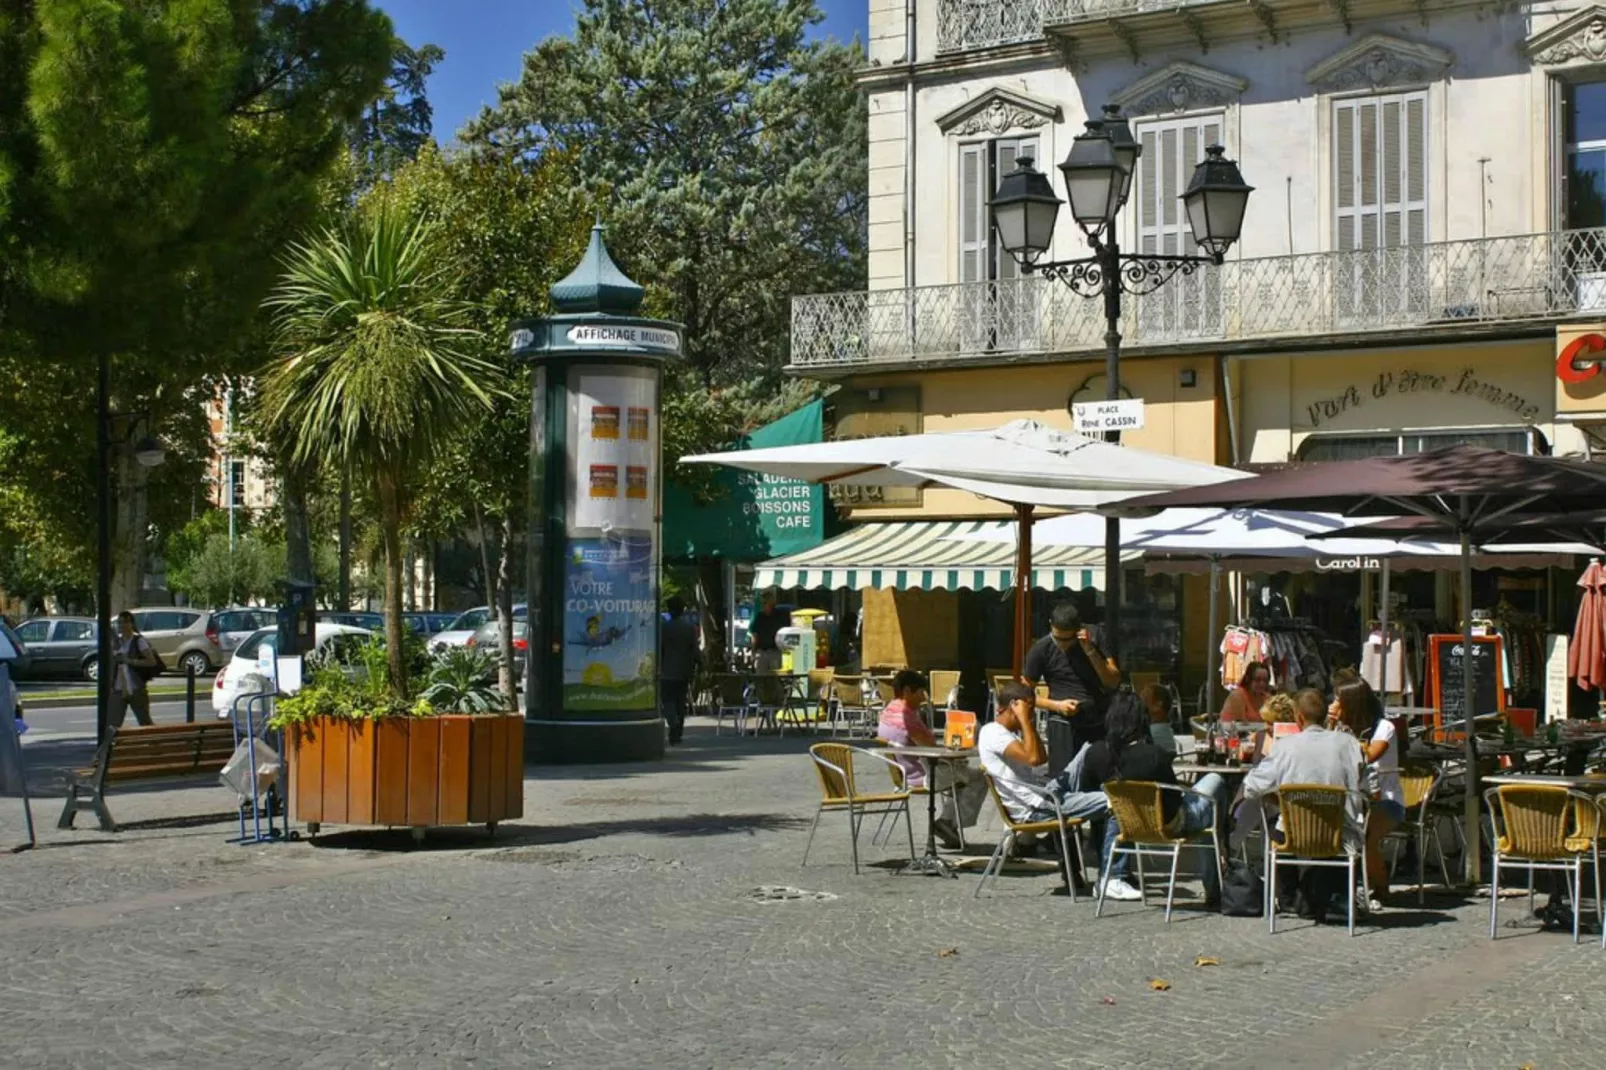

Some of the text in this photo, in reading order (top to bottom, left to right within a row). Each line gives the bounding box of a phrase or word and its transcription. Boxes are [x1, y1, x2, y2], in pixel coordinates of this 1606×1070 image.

[576, 328, 636, 341] AFFICHAGE
[1450, 367, 1540, 418] femme
[1097, 406, 1119, 414] PLACE
[1105, 416, 1137, 427] CASSIN
[755, 486, 810, 499] GLACIER
[743, 501, 811, 515] BOISSONS
[776, 516, 811, 528] CAFE
[571, 581, 613, 595] VOTRE
